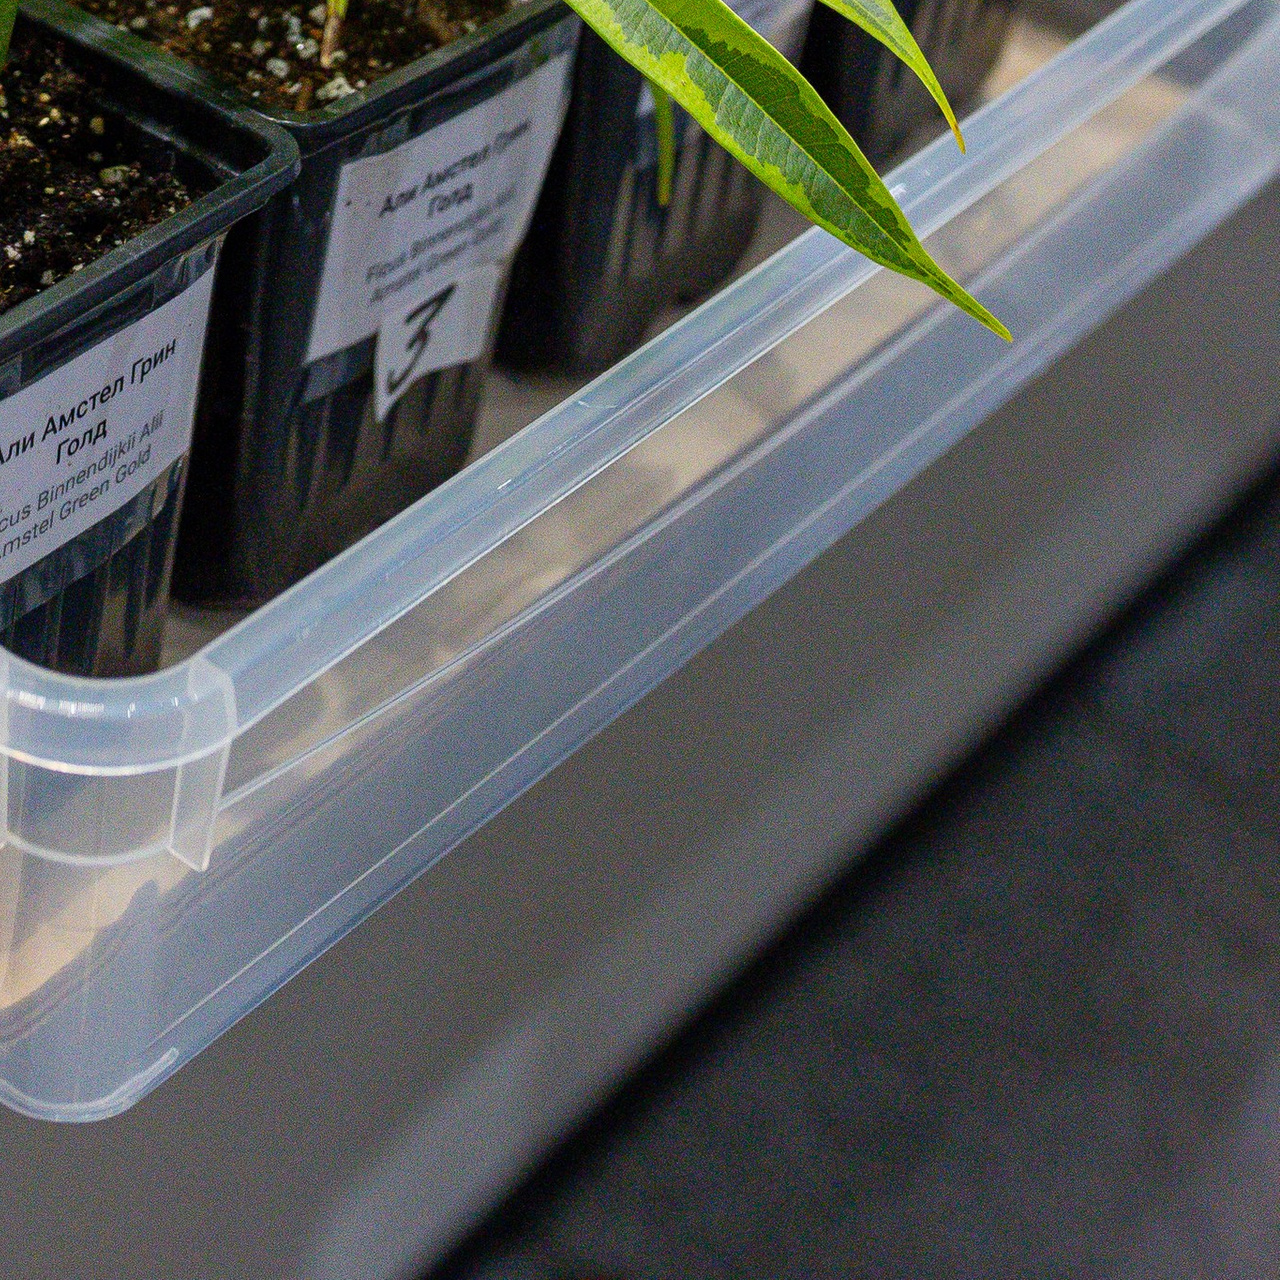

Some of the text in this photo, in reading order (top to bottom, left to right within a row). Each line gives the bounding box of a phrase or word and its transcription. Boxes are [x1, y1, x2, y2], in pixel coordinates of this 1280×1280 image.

[41, 374, 125, 443] Амстел
[130, 338, 178, 385] Грин
[55, 418, 108, 465] Голд
[58, 478, 110, 521] Green
[115, 443, 152, 485] Gold
